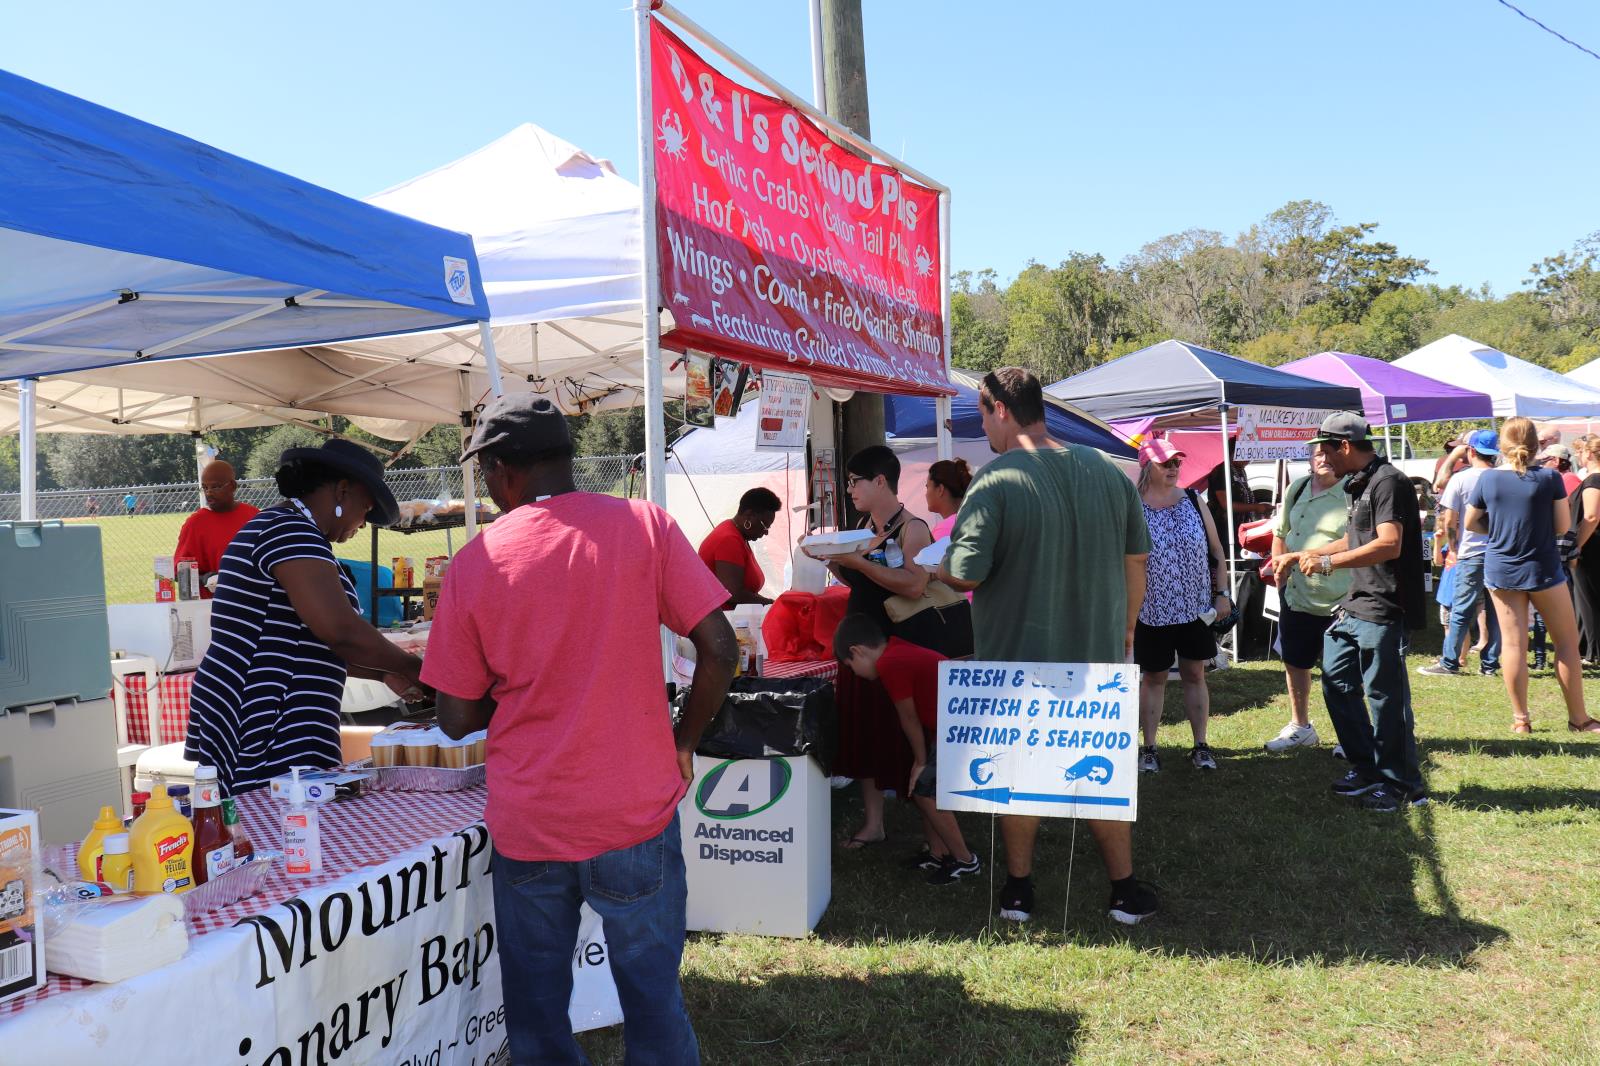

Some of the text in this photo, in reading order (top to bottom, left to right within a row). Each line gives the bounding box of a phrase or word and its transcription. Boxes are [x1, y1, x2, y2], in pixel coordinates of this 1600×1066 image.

[698, 72, 724, 133] &
[692, 182, 736, 234] Hot
[753, 167, 809, 219] Crabs
[859, 222, 883, 257] Tail
[667, 226, 941, 362] Wings Conch Fried Garlic Shrimp
[711, 300, 798, 363] Featuring
[795, 327, 850, 368] Grilled
[847, 342, 895, 381] Shrimp
[1260, 408, 1329, 426] MACKEY'S MUNC
[1261, 429, 1274, 439] NEW
[1274, 430, 1297, 439] ORLEANS
[1267, 446, 1297, 459] BEIGNETS
[949, 668, 1007, 688] FRESH
[1012, 669, 1025, 687] &
[947, 697, 1121, 720] CATFISH & TILAPIA
[946, 725, 1131, 750] SHRIMP & SEAFOOD
[694, 822, 794, 843] Advanced
[159, 835, 187, 857] French's
[699, 844, 784, 865] Disposal
[165, 860, 187, 873] YELLOW
[233, 843, 448, 989] Mount
[465, 1004, 505, 1046] Gree
